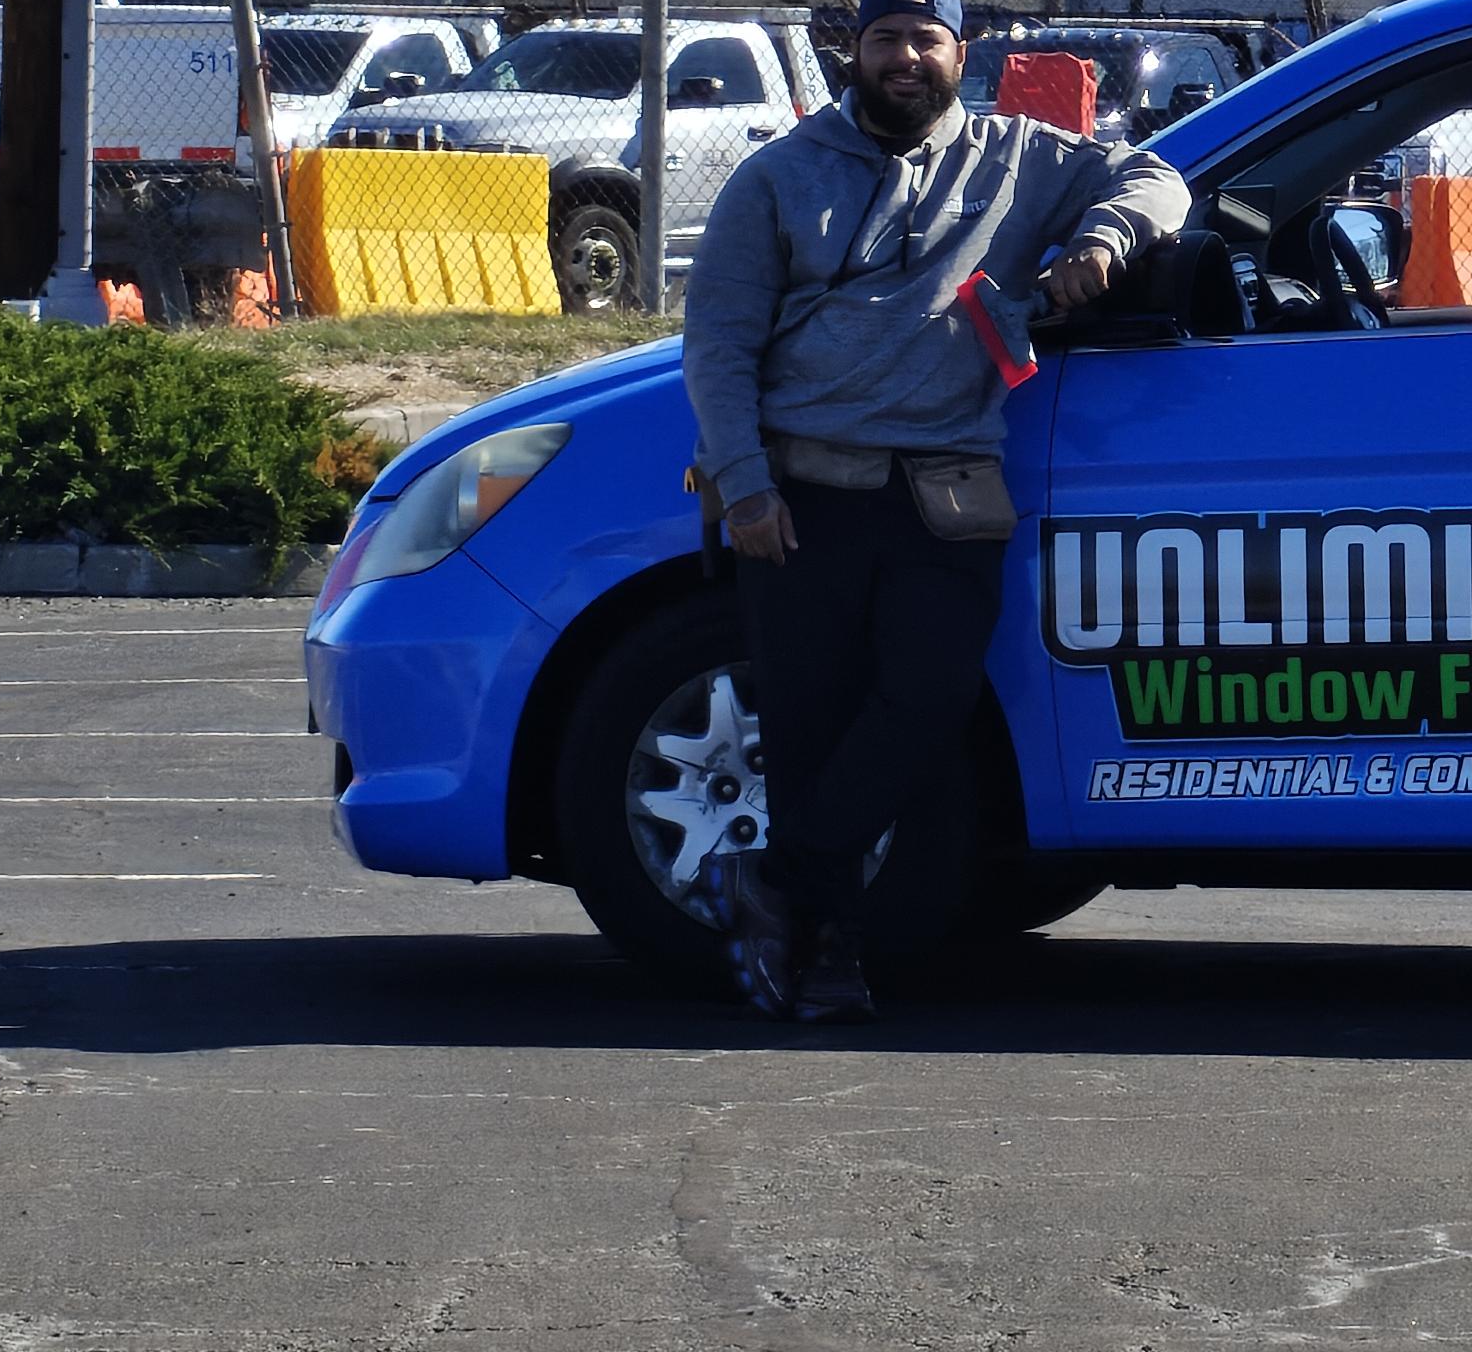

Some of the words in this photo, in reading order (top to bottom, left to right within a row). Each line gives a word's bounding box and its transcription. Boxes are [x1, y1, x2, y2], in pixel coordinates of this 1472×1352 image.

[1124, 656, 1417, 725] Window
[1089, 757, 1358, 802] RESIDENTIAL
[1366, 757, 1395, 793] &
